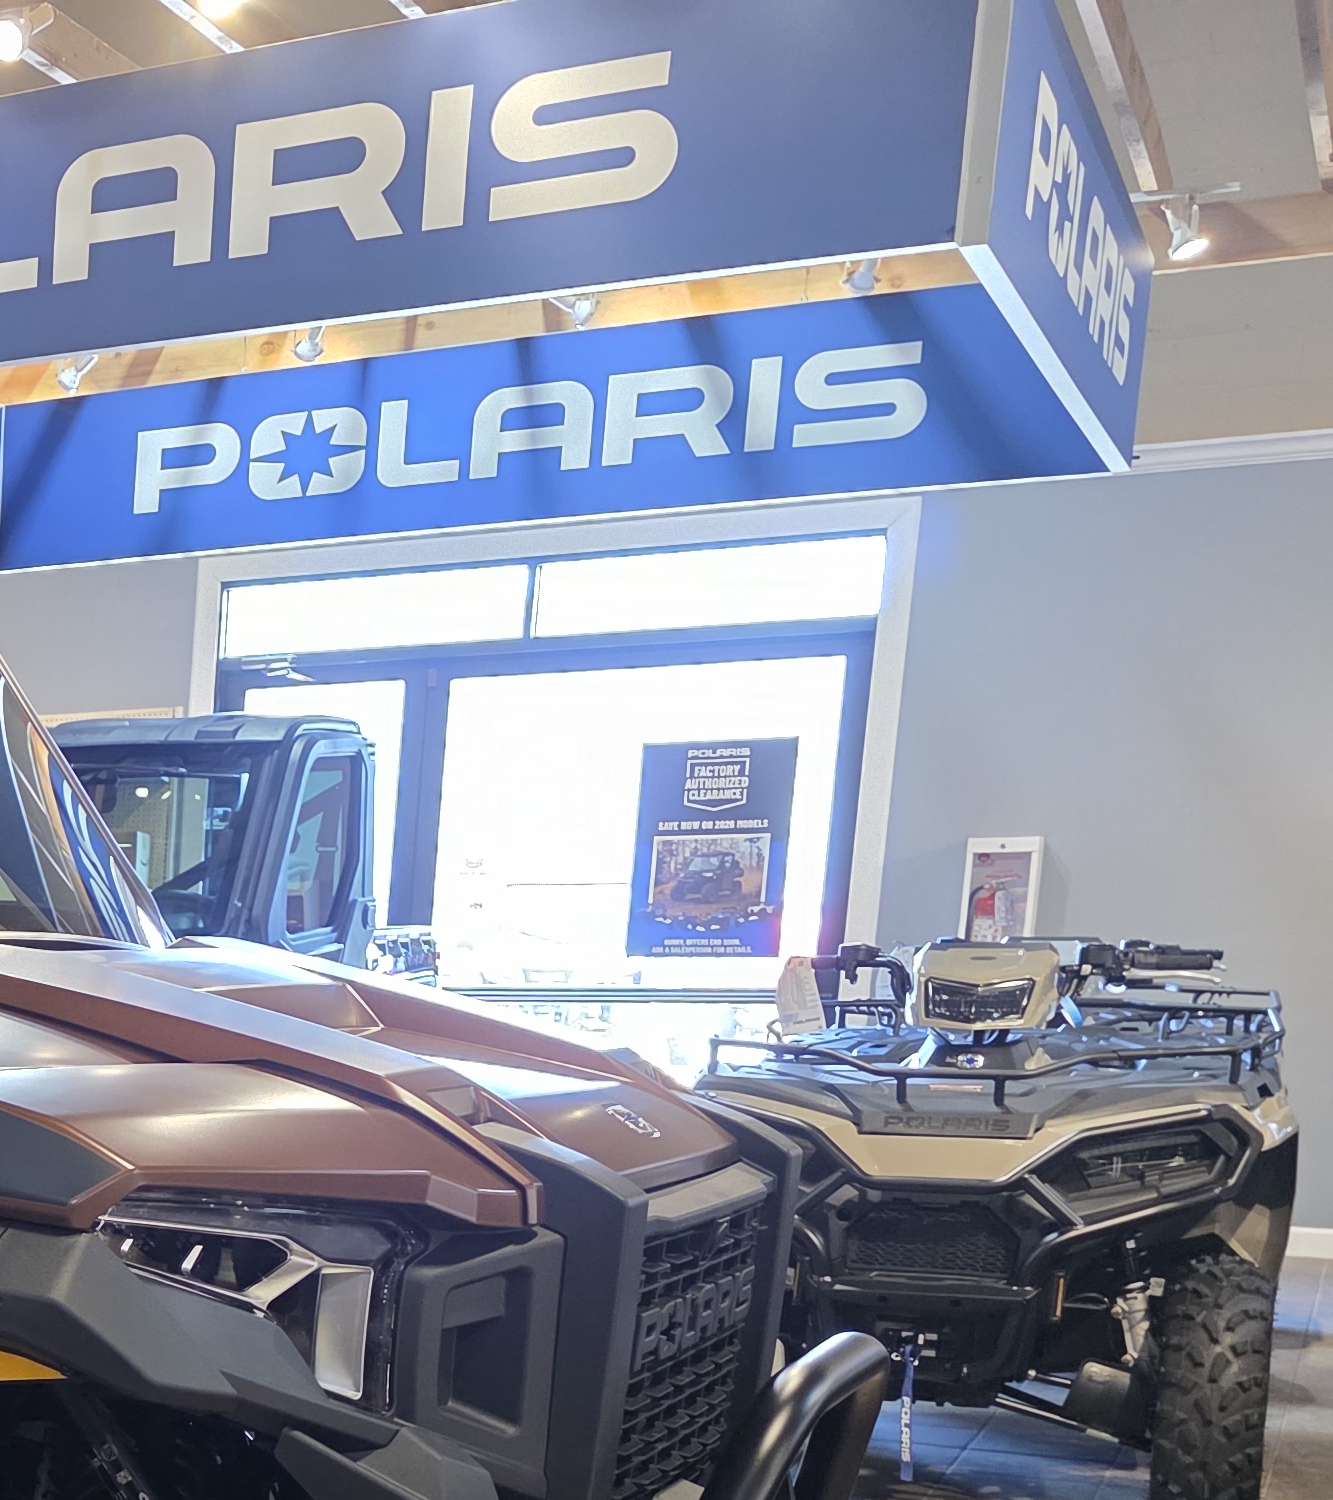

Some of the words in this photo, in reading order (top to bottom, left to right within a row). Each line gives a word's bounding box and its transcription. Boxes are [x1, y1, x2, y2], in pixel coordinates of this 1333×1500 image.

[1025, 70, 1135, 386] POLARIS
[133, 341, 928, 514] POLARIS
[687, 747, 751, 758] POLARIS
[694, 764, 741, 777] FACTORY
[685, 777, 749, 790] AUTHORIZED
[688, 789, 742, 801] CLEARANCE
[883, 1114, 1012, 1133] POLARIS
[901, 1395, 911, 1463] POLARIS
